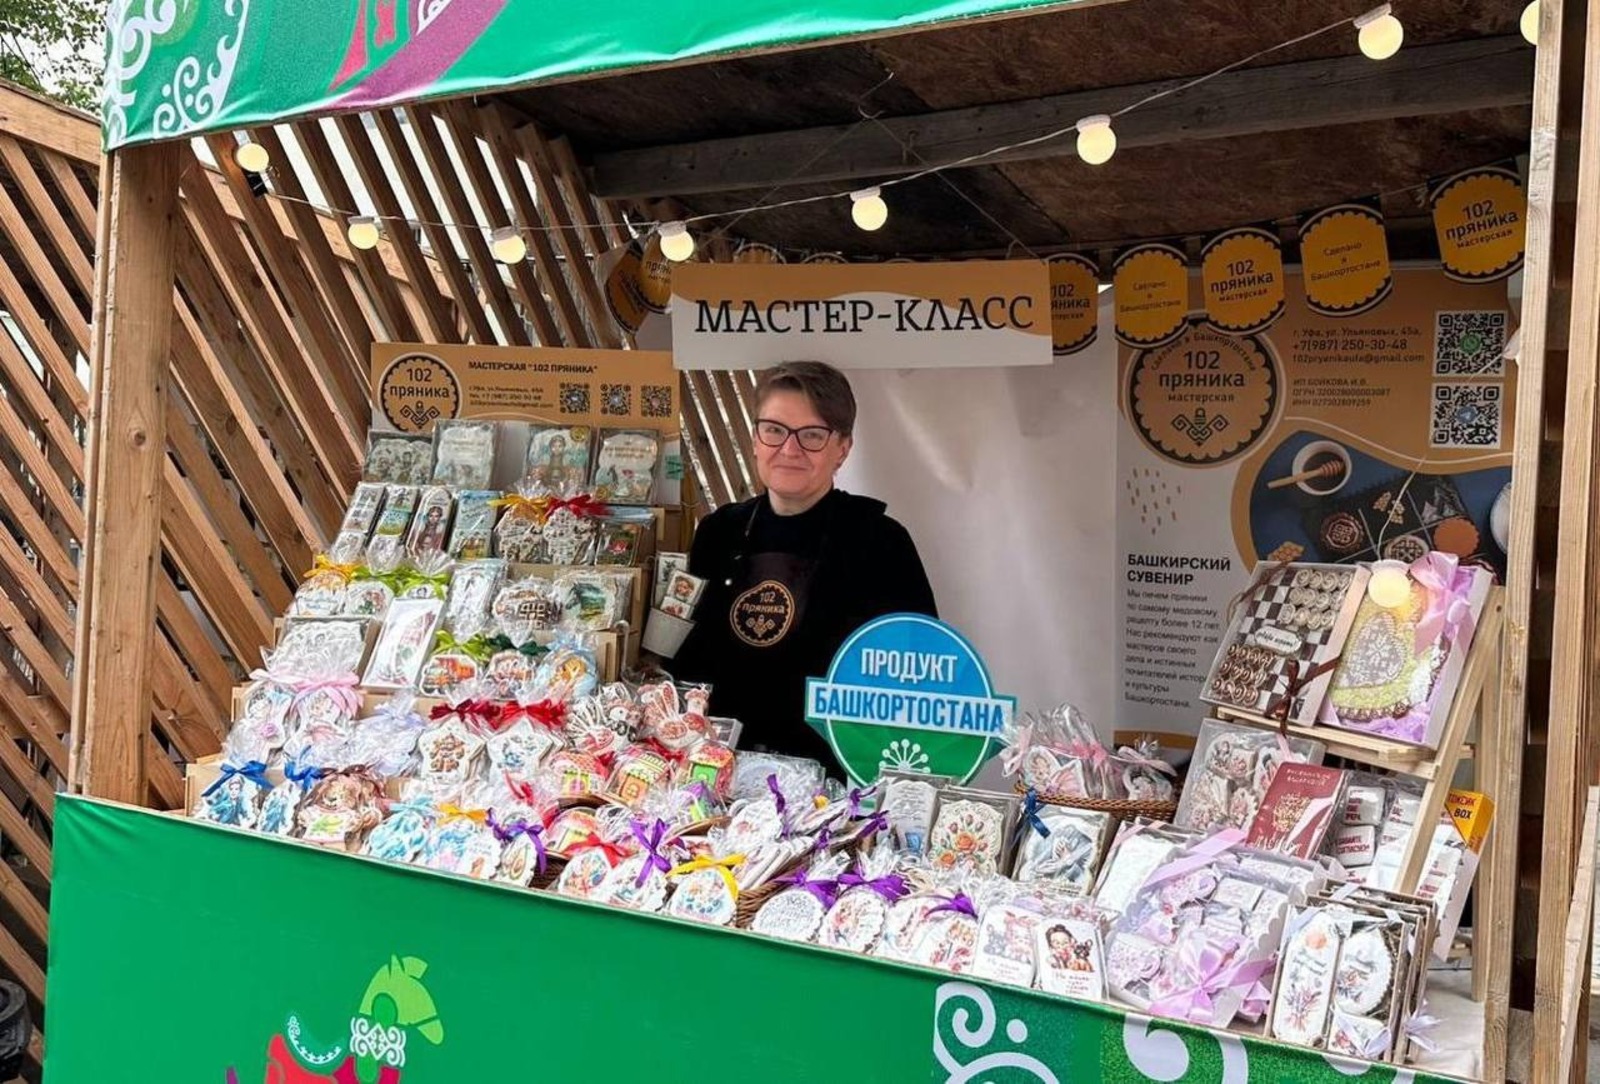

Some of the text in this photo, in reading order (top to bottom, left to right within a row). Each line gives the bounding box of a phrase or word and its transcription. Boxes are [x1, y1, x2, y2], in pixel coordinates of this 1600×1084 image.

[1463, 200, 1495, 221] 102
[1445, 211, 1519, 241] пряника
[1456, 229, 1514, 249] мастерская
[1227, 259, 1256, 277] 102
[1210, 271, 1275, 294] пряника
[1051, 284, 1074, 298] 102
[1218, 288, 1268, 302] мастерская
[1051, 298, 1090, 310] яника
[694, 295, 1035, 333] МАСТЕР-КЛАСС
[1341, 338, 1408, 351] 250-30-48
[468, 361, 527, 371] МАСТЕРСКАЯ
[1183, 350, 1221, 370] 102
[406, 368, 432, 382] 102
[1159, 373, 1245, 391] пряника
[390, 386, 450, 399] пряника
[1168, 393, 1235, 403] мастерская
[1128, 553, 1231, 571] БАШКИРСКИЙ
[1127, 570, 1194, 585] СУВЕНИР
[759, 591, 776, 603] 102
[742, 603, 785, 614] пряника
[1161, 618, 1188, 628] более
[1191, 619, 1202, 628] 12
[1143, 631, 1202, 643] рекомендуют
[860, 647, 958, 684] ПРОДУКТ
[814, 686, 1004, 732] БАШКОРТОСТАНА
[1454, 808, 1472, 820] BOX
